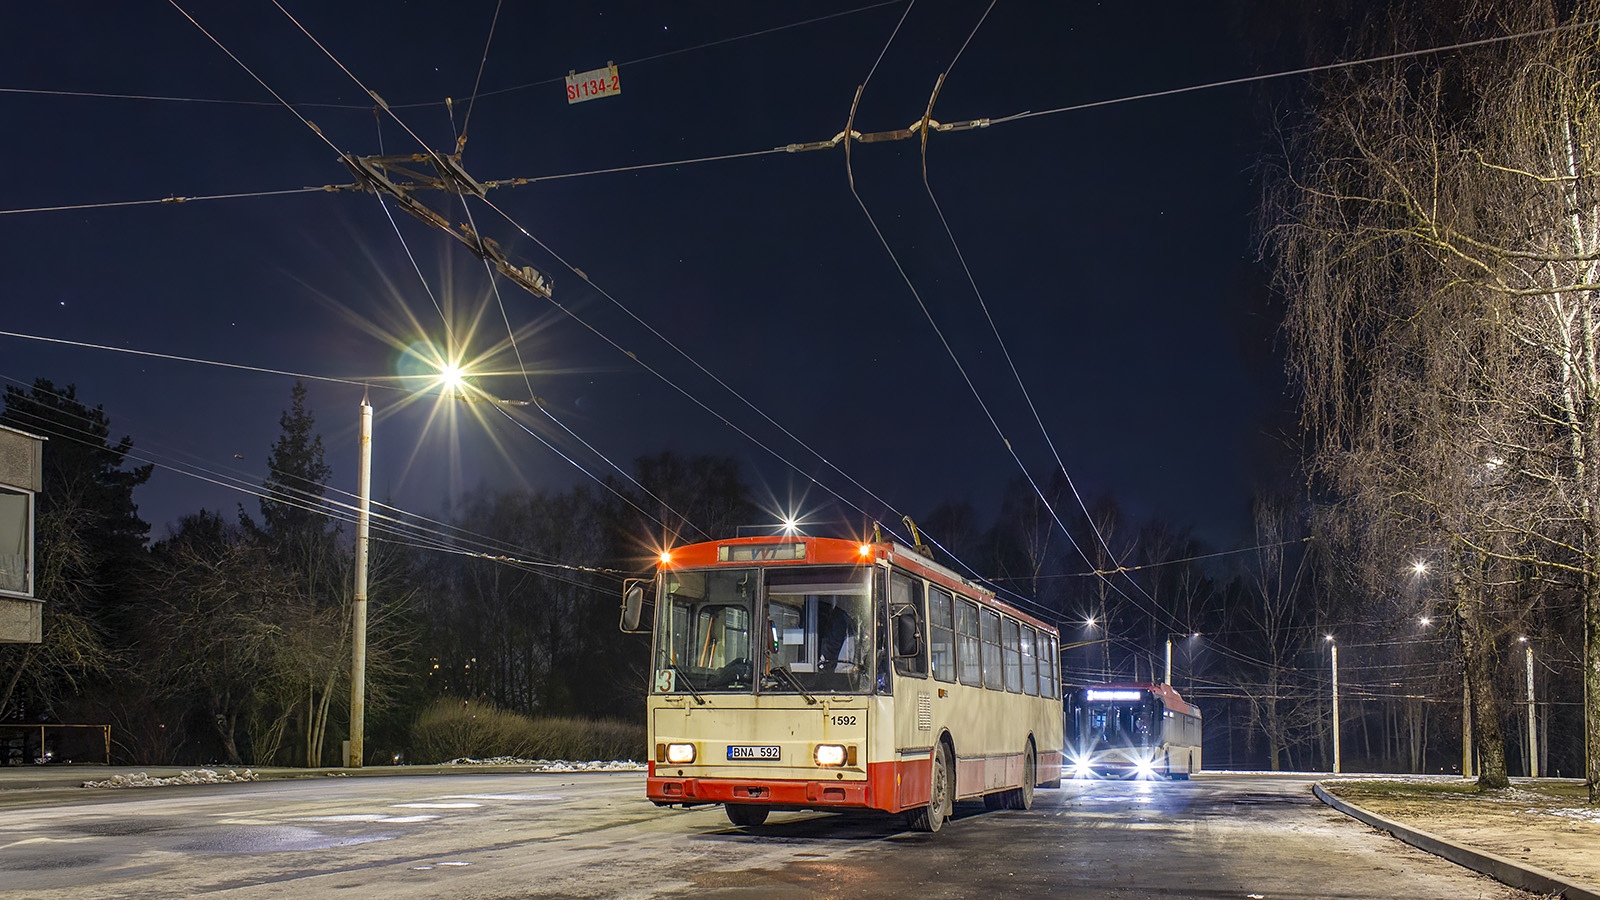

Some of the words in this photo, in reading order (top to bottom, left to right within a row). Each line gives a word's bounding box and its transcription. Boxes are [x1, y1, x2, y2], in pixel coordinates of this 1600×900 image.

[660, 670, 672, 692] 3
[831, 715, 857, 726] 1592
[733, 747, 754, 757] BNA
[760, 747, 778, 757] 592
